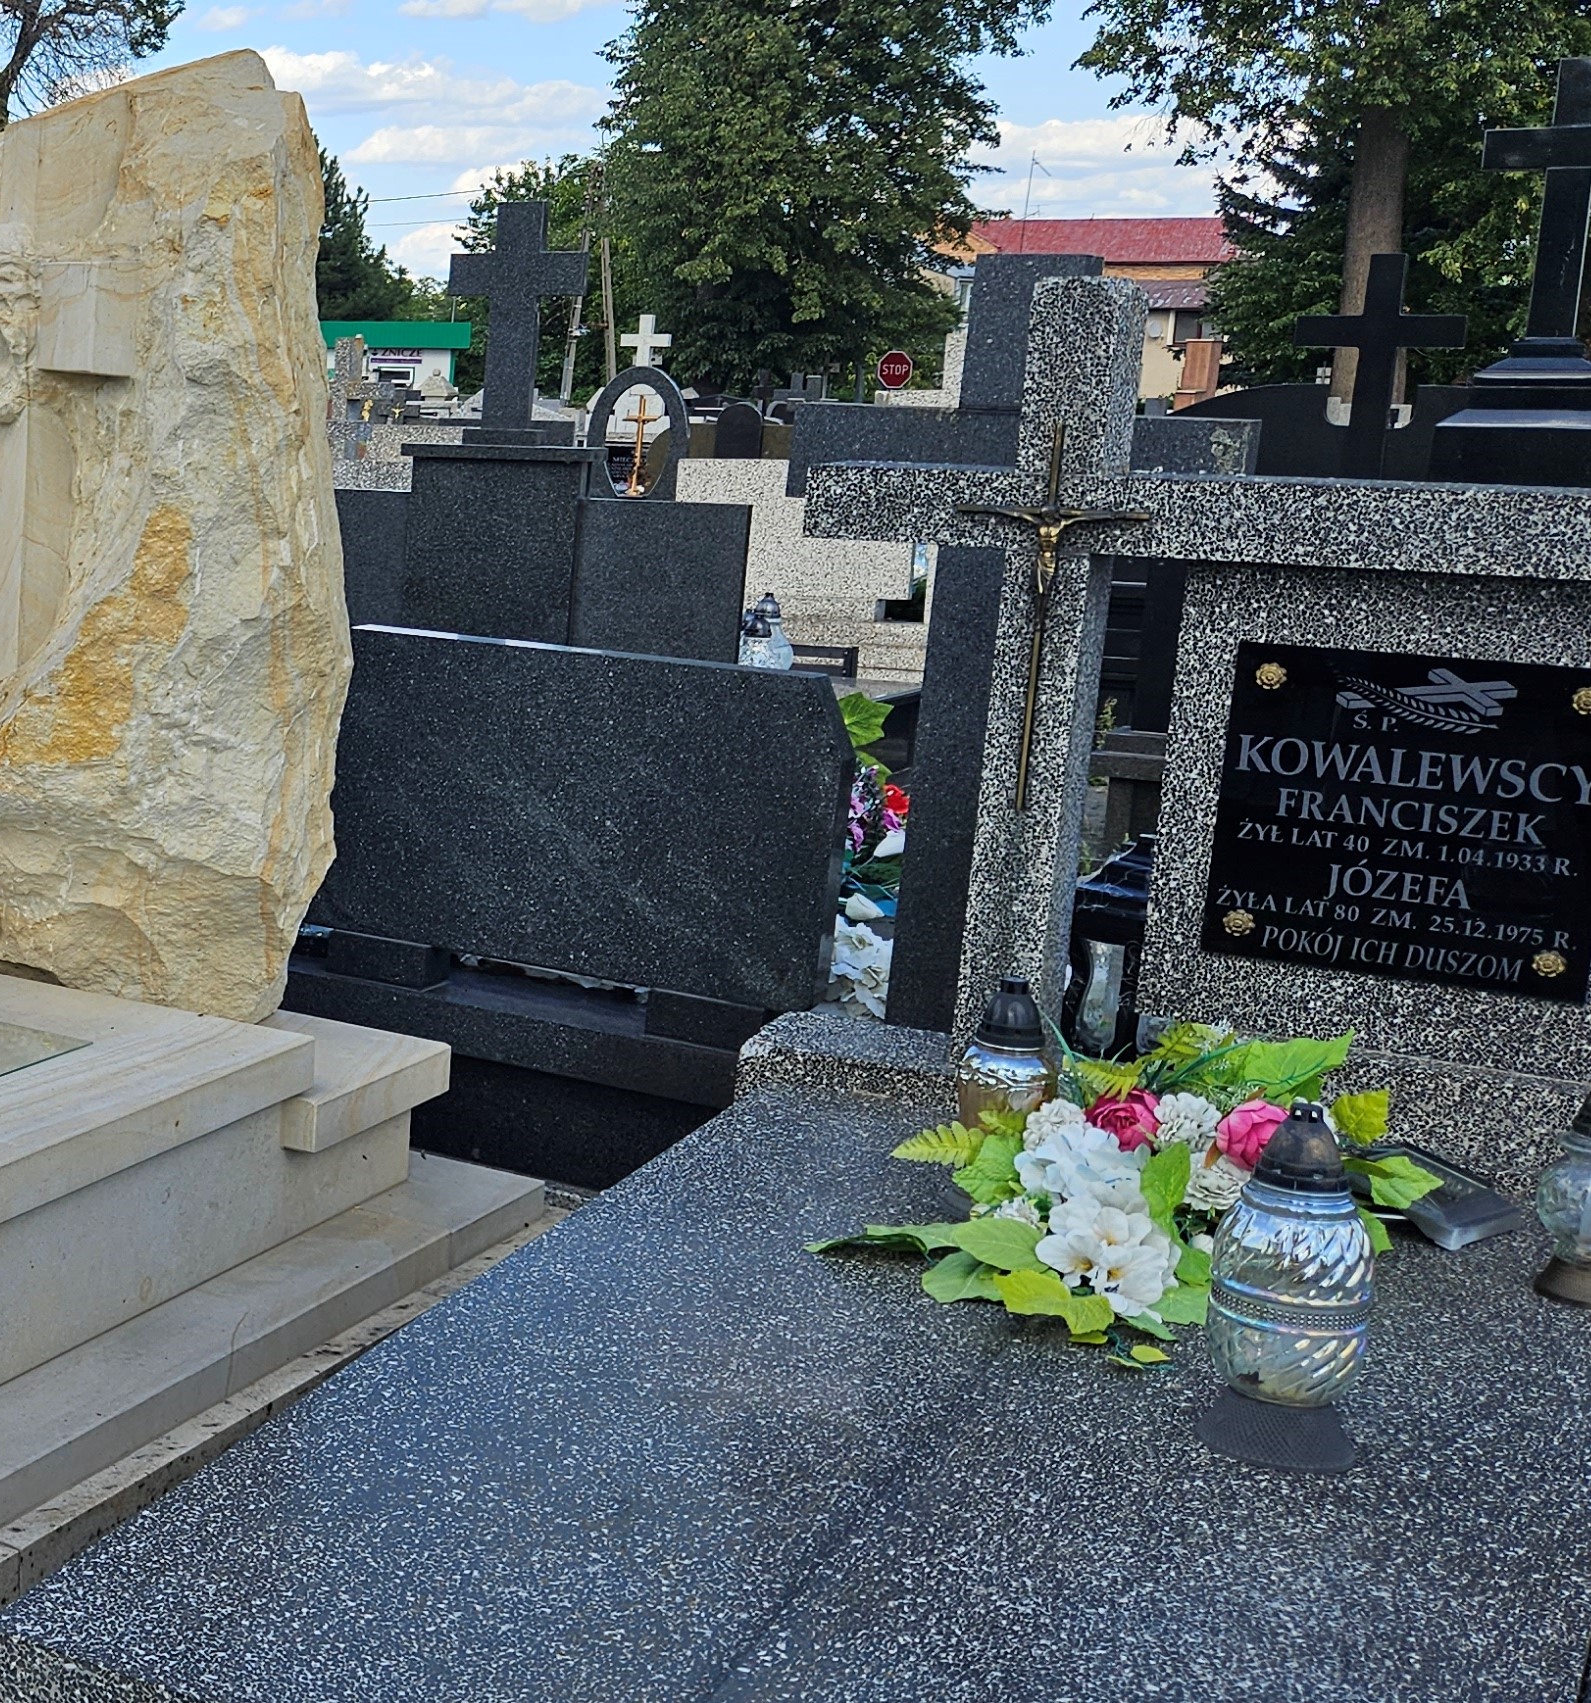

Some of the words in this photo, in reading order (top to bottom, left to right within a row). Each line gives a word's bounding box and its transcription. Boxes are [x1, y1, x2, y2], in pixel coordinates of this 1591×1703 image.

[381, 348, 423, 357] ZNICZE
[882, 364, 909, 375] STOP
[1235, 733, 1591, 806] KOWALEWSCY
[1275, 787, 1547, 846] FRANCISZEK
[1237, 817, 1284, 844] ŻYŁ
[1291, 828, 1338, 849] LAT
[1343, 834, 1370, 852] 40
[1381, 838, 1430, 861] ZM.
[1552, 857, 1578, 877] R.
[1323, 859, 1471, 911] JÓZEFA
[1215, 885, 1277, 912] ŻYŁA
[1284, 897, 1329, 919] LAT
[1334, 904, 1360, 922] 80
[1370, 907, 1417, 930] ZM.
[1428, 915, 1544, 946] 25.12.1975
[1552, 930, 1577, 951] R.
[1260, 925, 1344, 965] POKÓJ
[1349, 937, 1399, 966] ICH
[1404, 945, 1524, 983] DUSZOM
